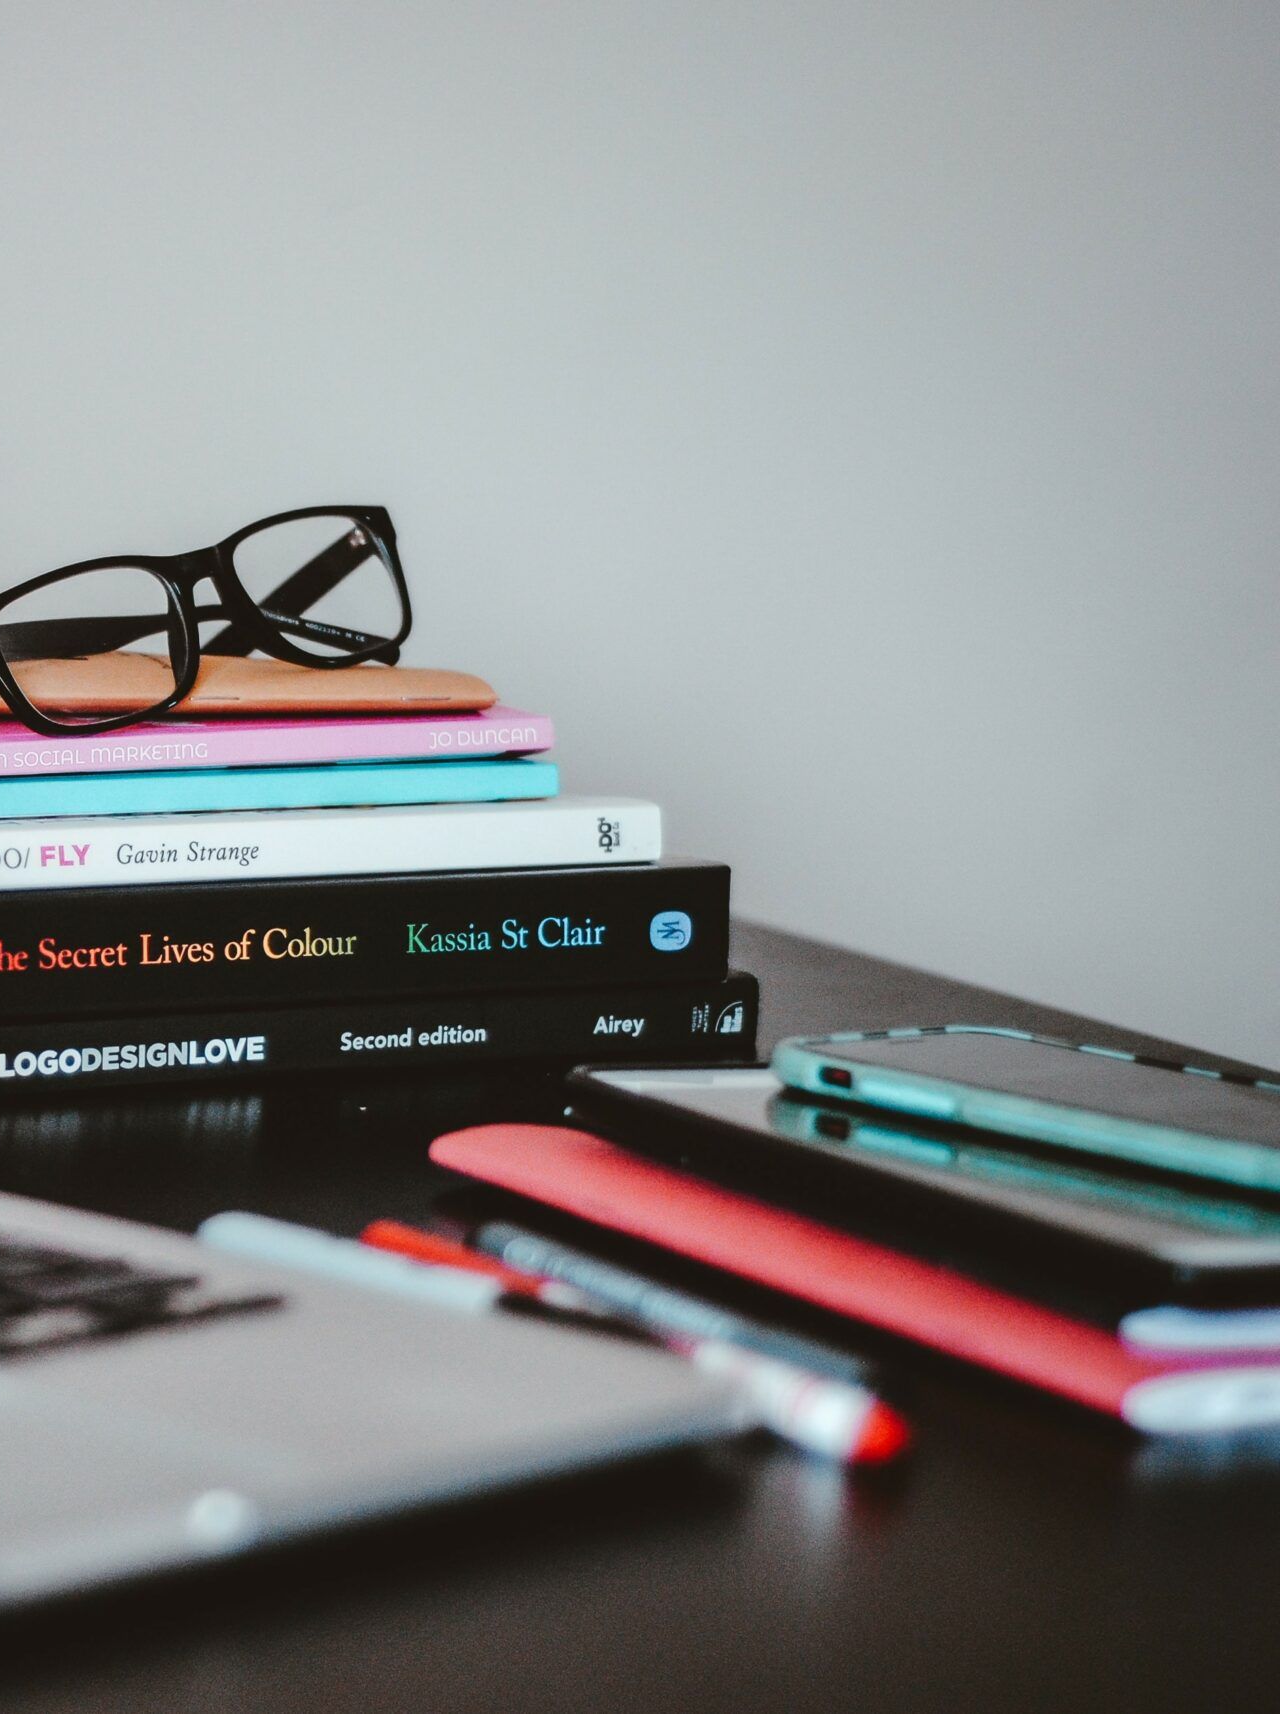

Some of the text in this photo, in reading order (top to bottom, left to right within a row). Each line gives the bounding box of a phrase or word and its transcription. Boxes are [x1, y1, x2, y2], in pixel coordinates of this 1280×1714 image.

[428, 727, 537, 750] JO DUNCAN
[13, 750, 86, 768] SOCIAL
[90, 743, 209, 764] MARKETING
[39, 843, 91, 867] FLY
[116, 840, 261, 867] Gavin Strange
[406, 915, 607, 955] Kassia St Clair
[38, 938, 128, 971] Secret
[139, 933, 215, 966] Lives
[224, 928, 256, 961] of
[262, 926, 358, 960] Colour
[340, 1023, 488, 1052] Second edition
[592, 1014, 646, 1039] Airey
